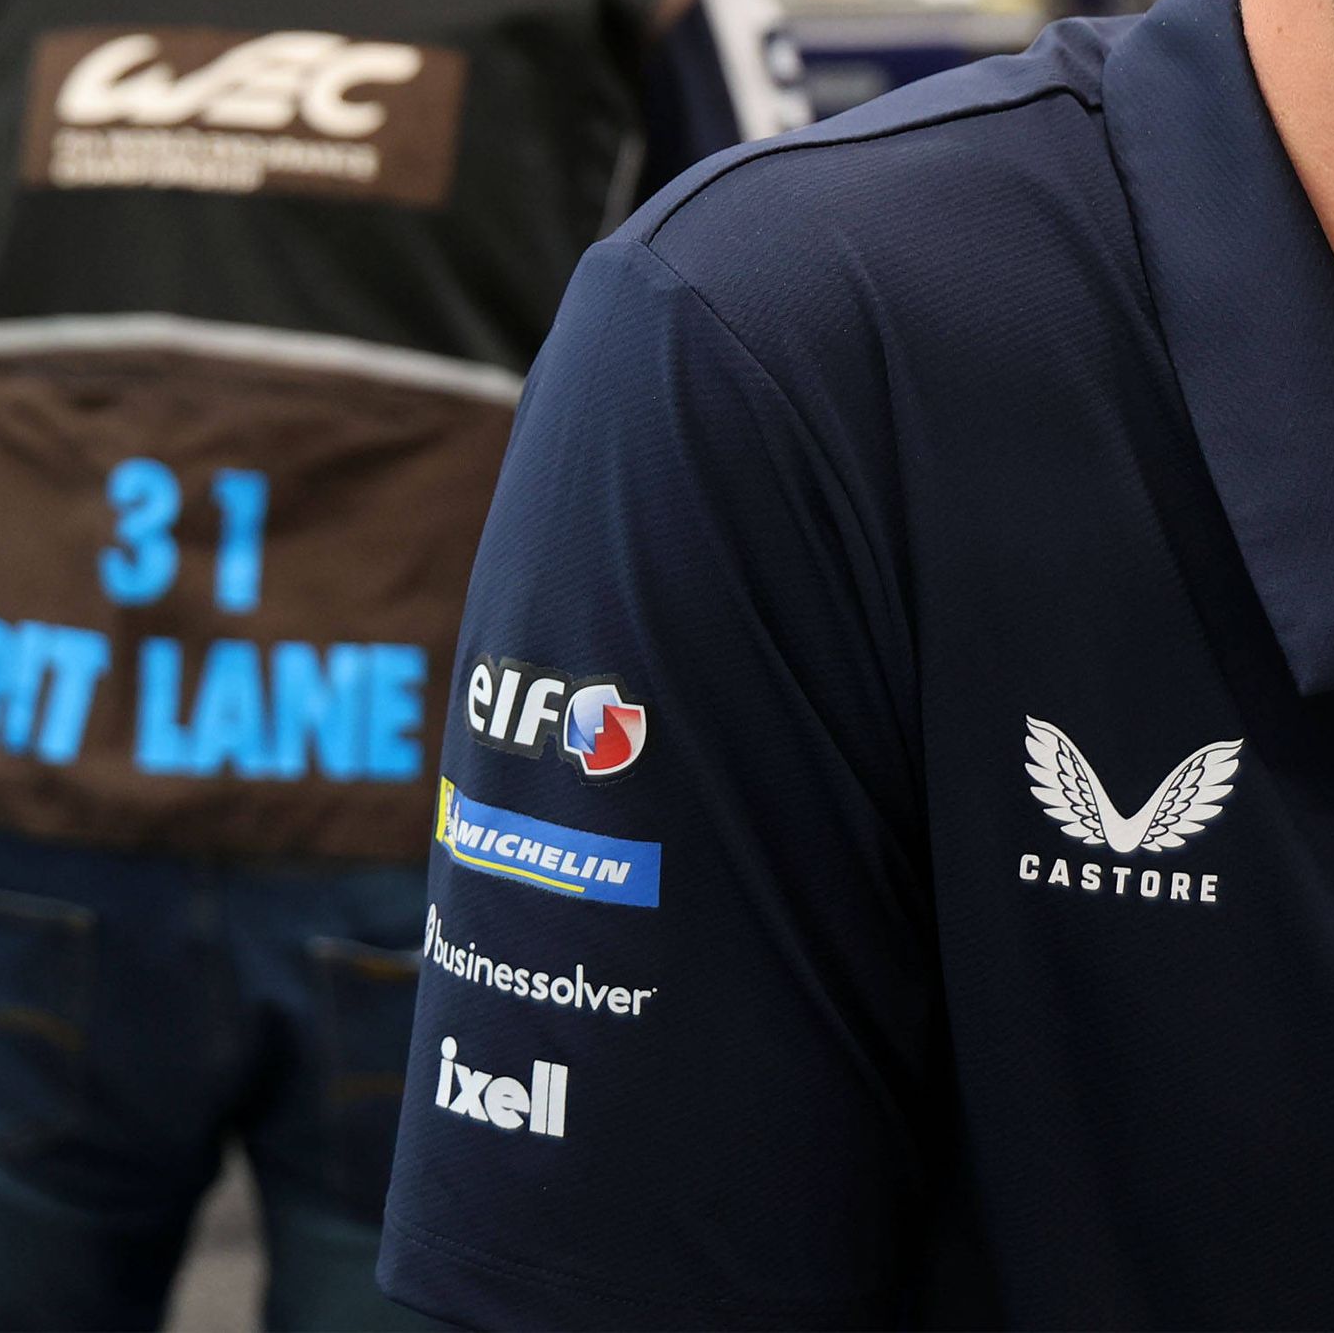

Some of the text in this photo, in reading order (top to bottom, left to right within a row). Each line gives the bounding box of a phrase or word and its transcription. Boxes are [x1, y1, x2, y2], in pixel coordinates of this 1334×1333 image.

[54, 30, 422, 138] WEC
[135, 637, 427, 781] LANE
[468, 664, 565, 746] elf
[457, 819, 632, 884] MICHELIN
[1019, 853, 1219, 903] CASTORE
[433, 917, 653, 1016] businessolver
[435, 1036, 568, 1138] ixell
